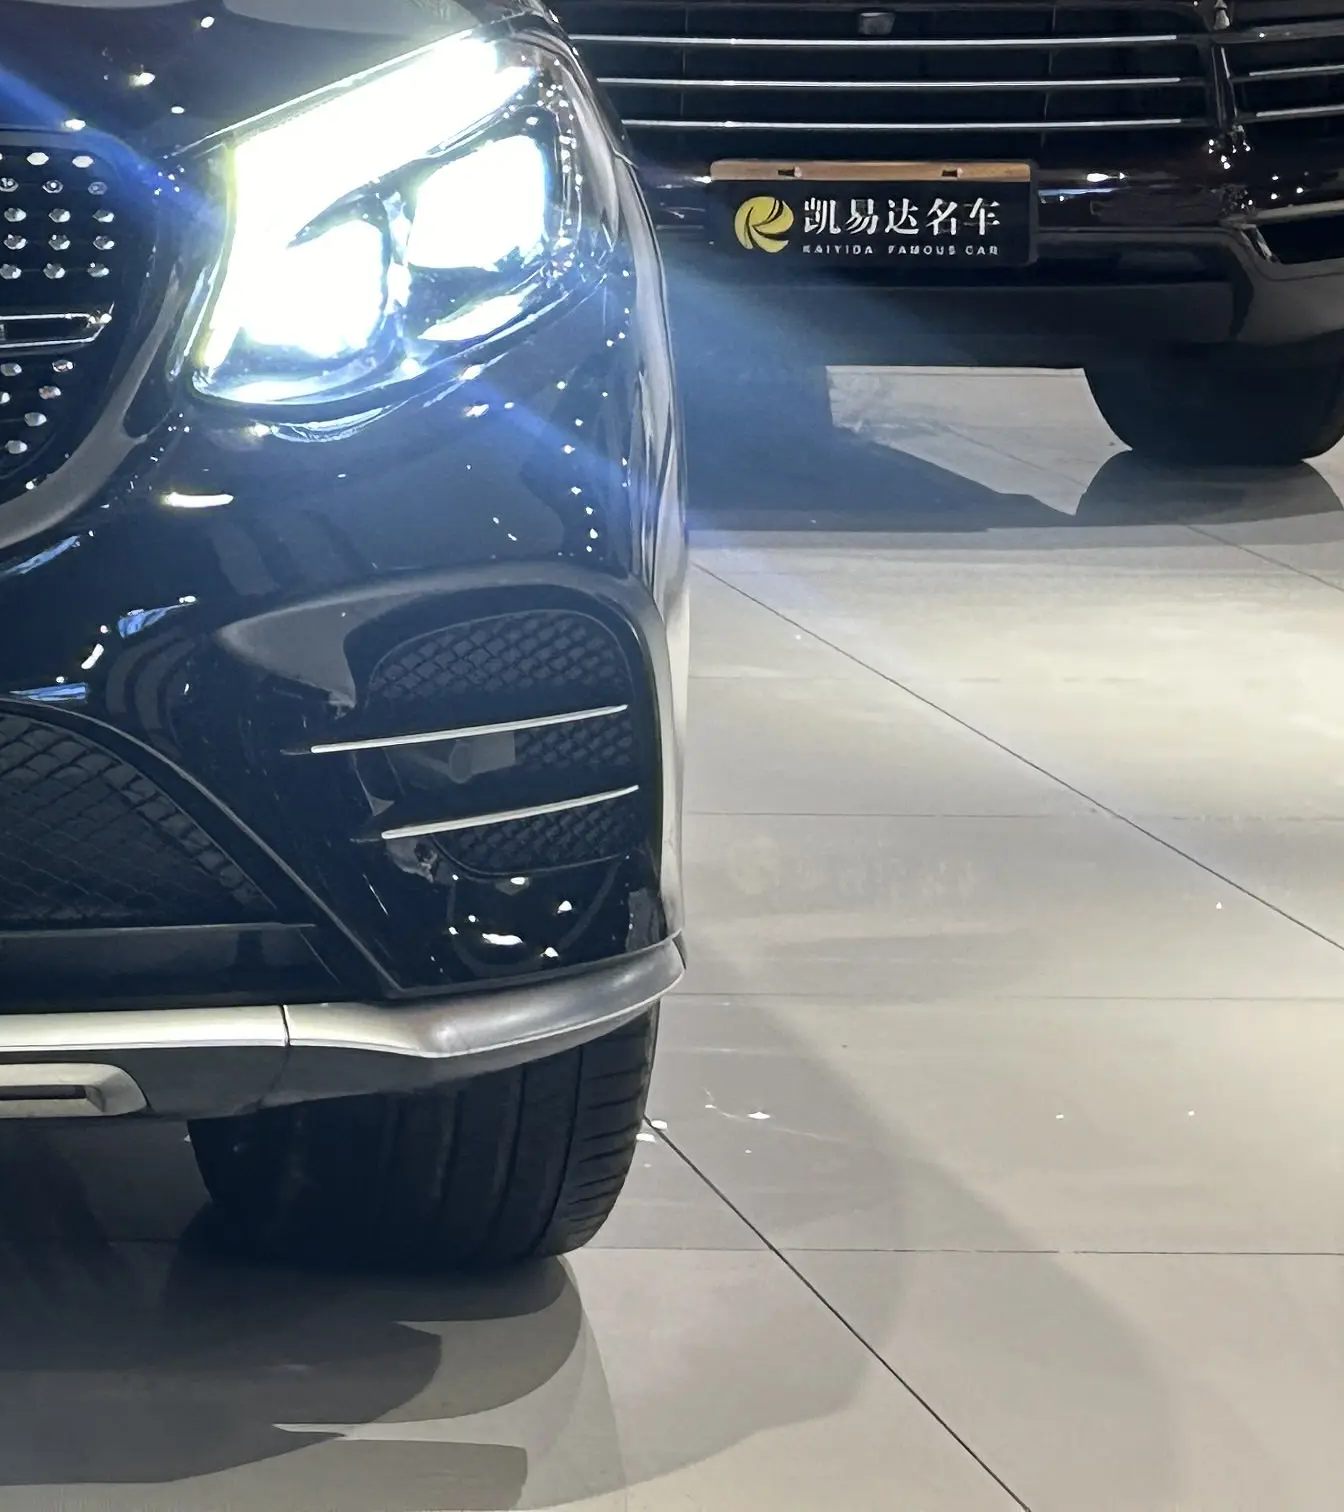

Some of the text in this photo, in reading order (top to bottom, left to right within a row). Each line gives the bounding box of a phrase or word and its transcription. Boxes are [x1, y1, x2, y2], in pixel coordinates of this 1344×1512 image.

[804, 198, 1000, 235] 凯易达名车
[803, 245, 873, 254] KAIYIDA
